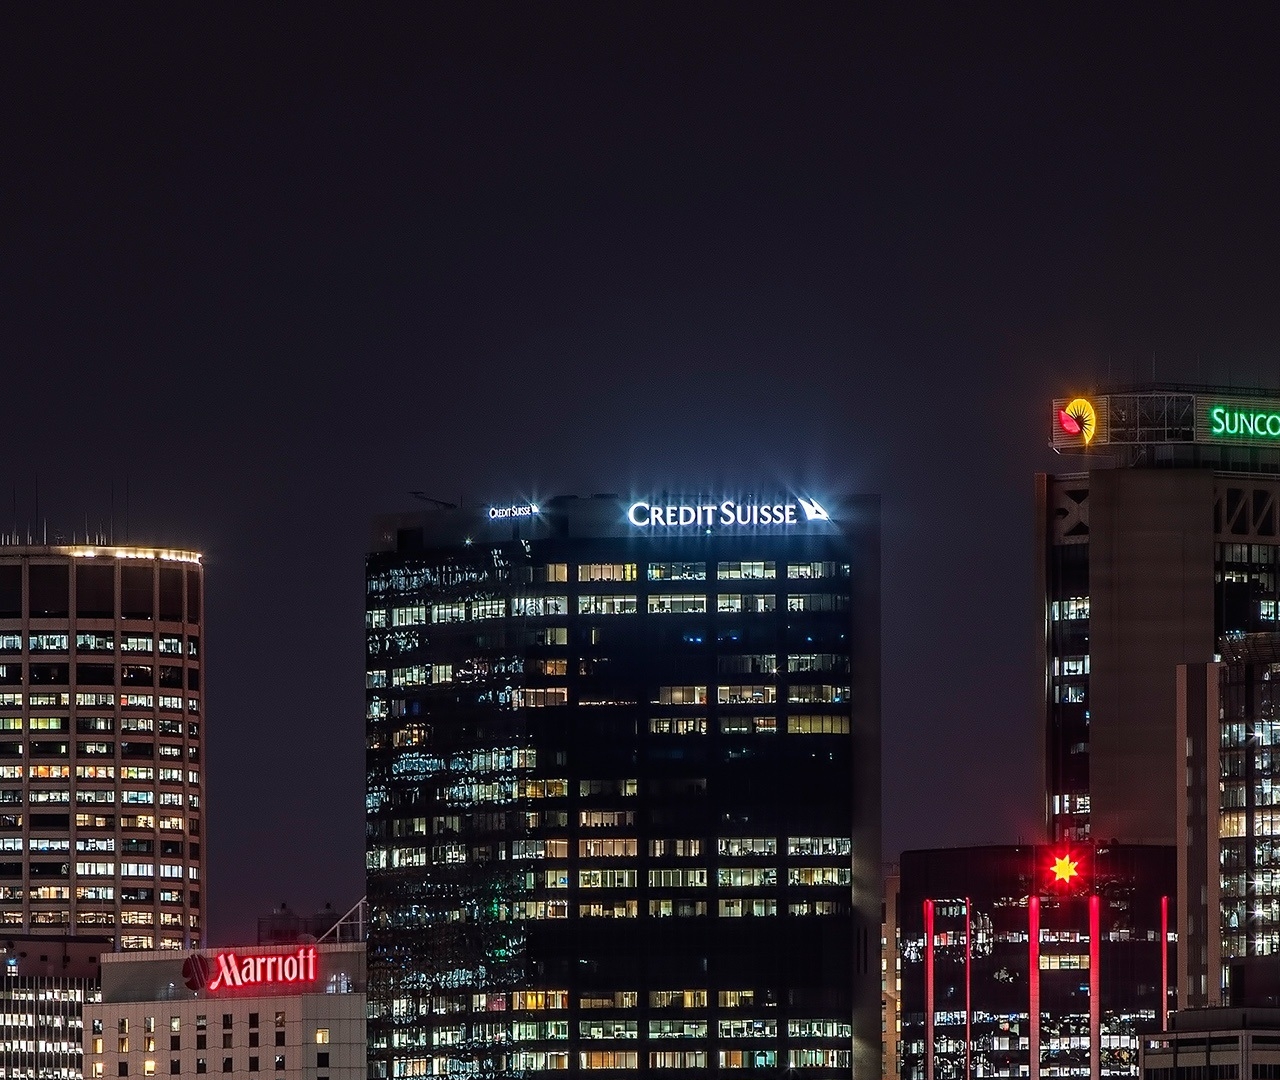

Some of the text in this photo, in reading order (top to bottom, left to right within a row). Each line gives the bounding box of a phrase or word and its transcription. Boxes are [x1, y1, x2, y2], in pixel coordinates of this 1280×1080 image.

[628, 501, 797, 527] CREDIT SUISSE
[209, 948, 316, 990] Marriott
